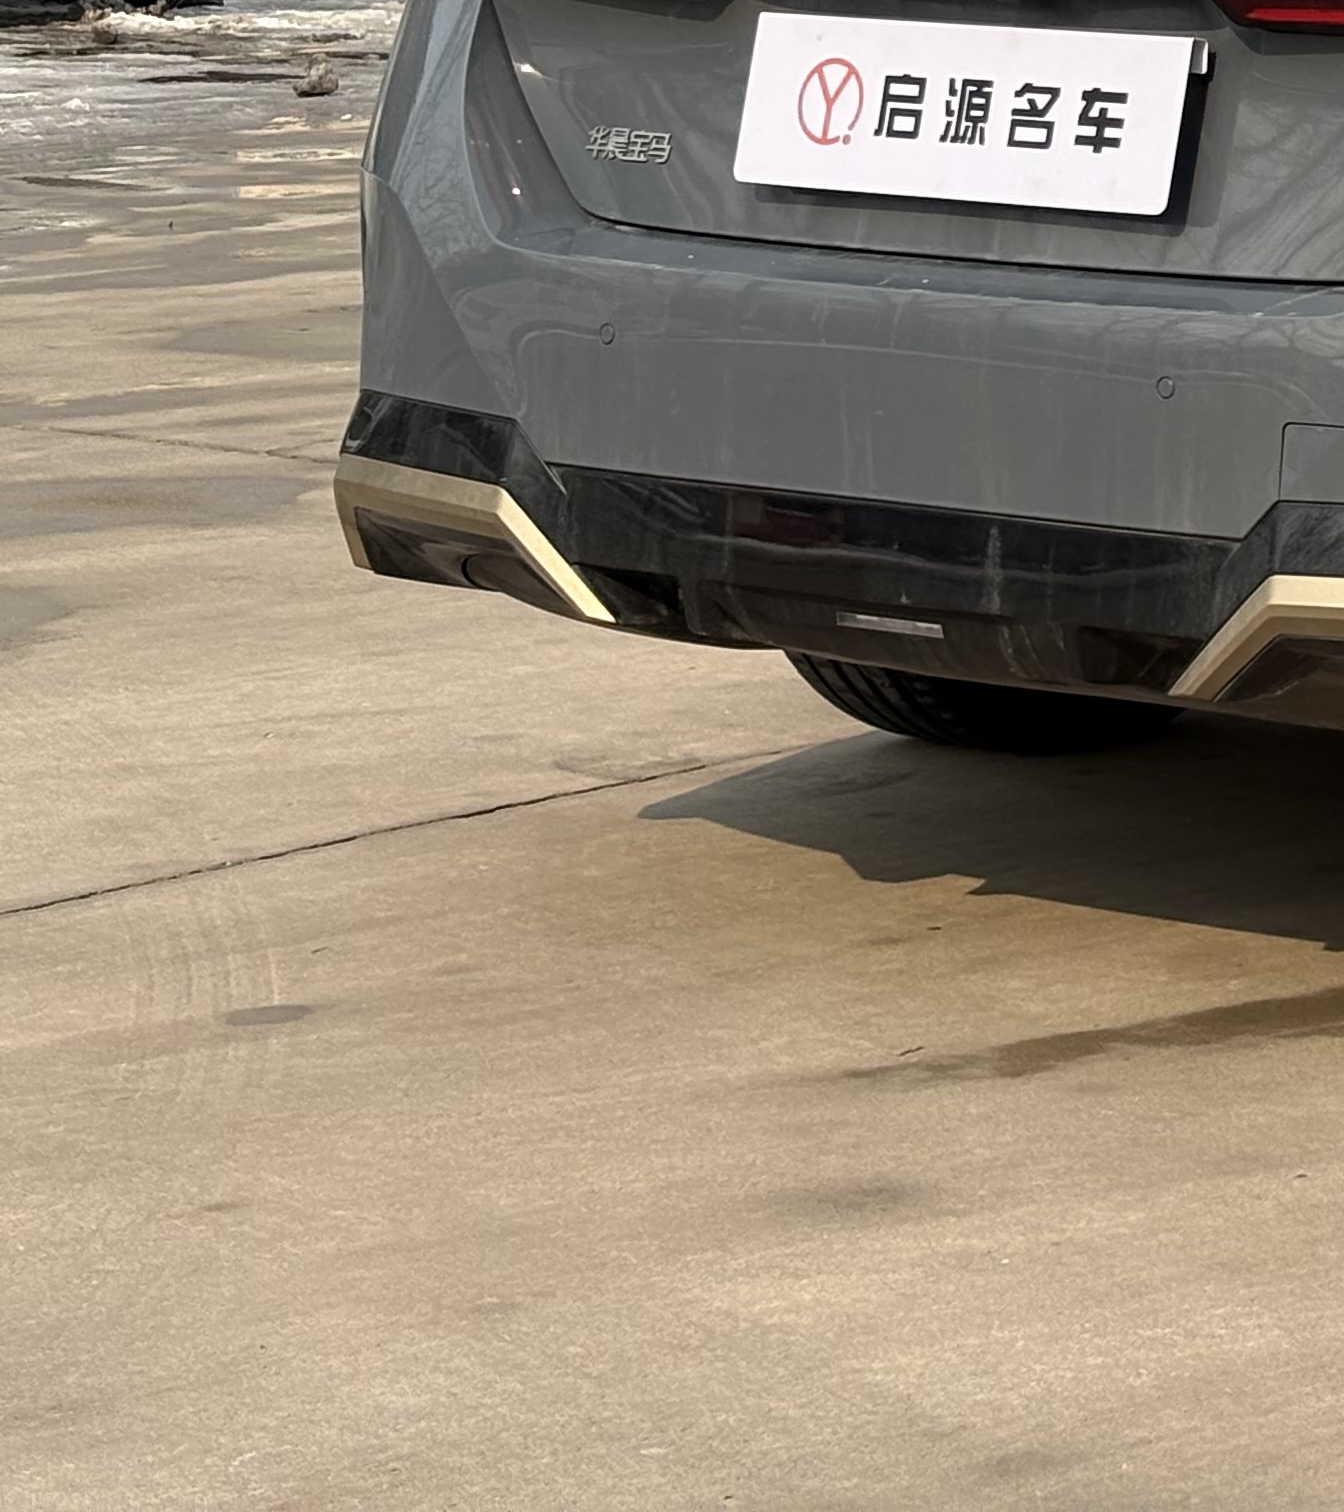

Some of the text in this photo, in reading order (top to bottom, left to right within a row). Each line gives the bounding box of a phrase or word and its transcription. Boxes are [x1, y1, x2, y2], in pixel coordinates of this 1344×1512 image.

[873, 73, 1130, 154] 启源名车
[585, 125, 672, 164] 华晨宝马
